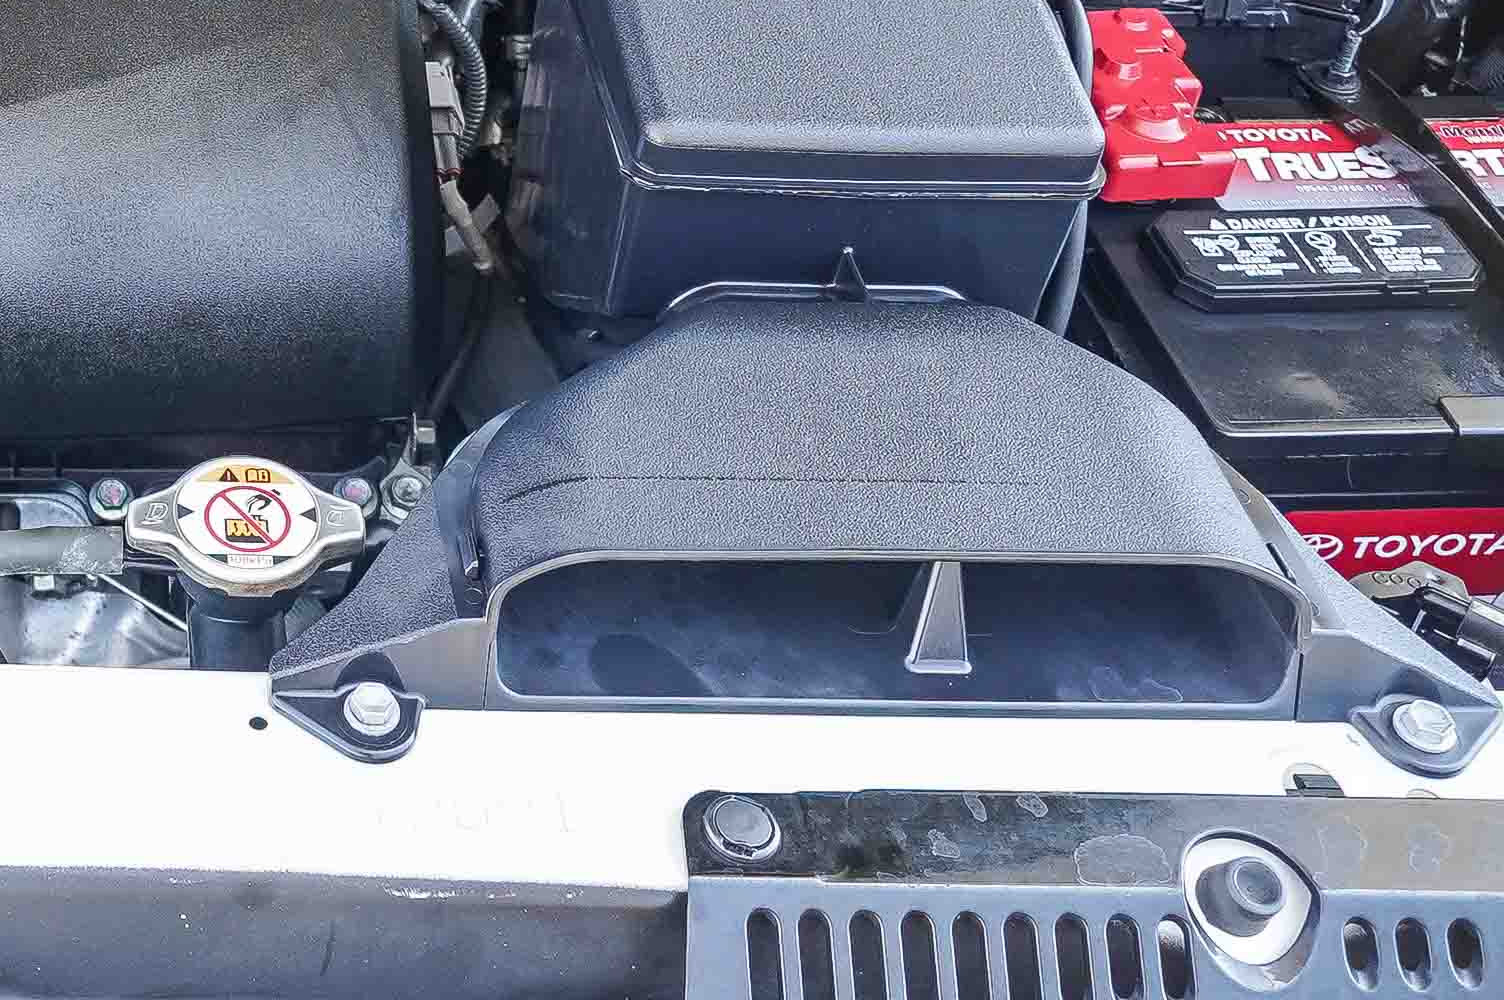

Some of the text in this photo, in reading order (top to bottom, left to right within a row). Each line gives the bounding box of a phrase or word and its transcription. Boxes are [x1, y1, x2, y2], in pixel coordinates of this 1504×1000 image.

[1225, 127, 1333, 144] TOYOTA
[1226, 216, 1306, 230] DANGER
[1320, 214, 1393, 227] POISON
